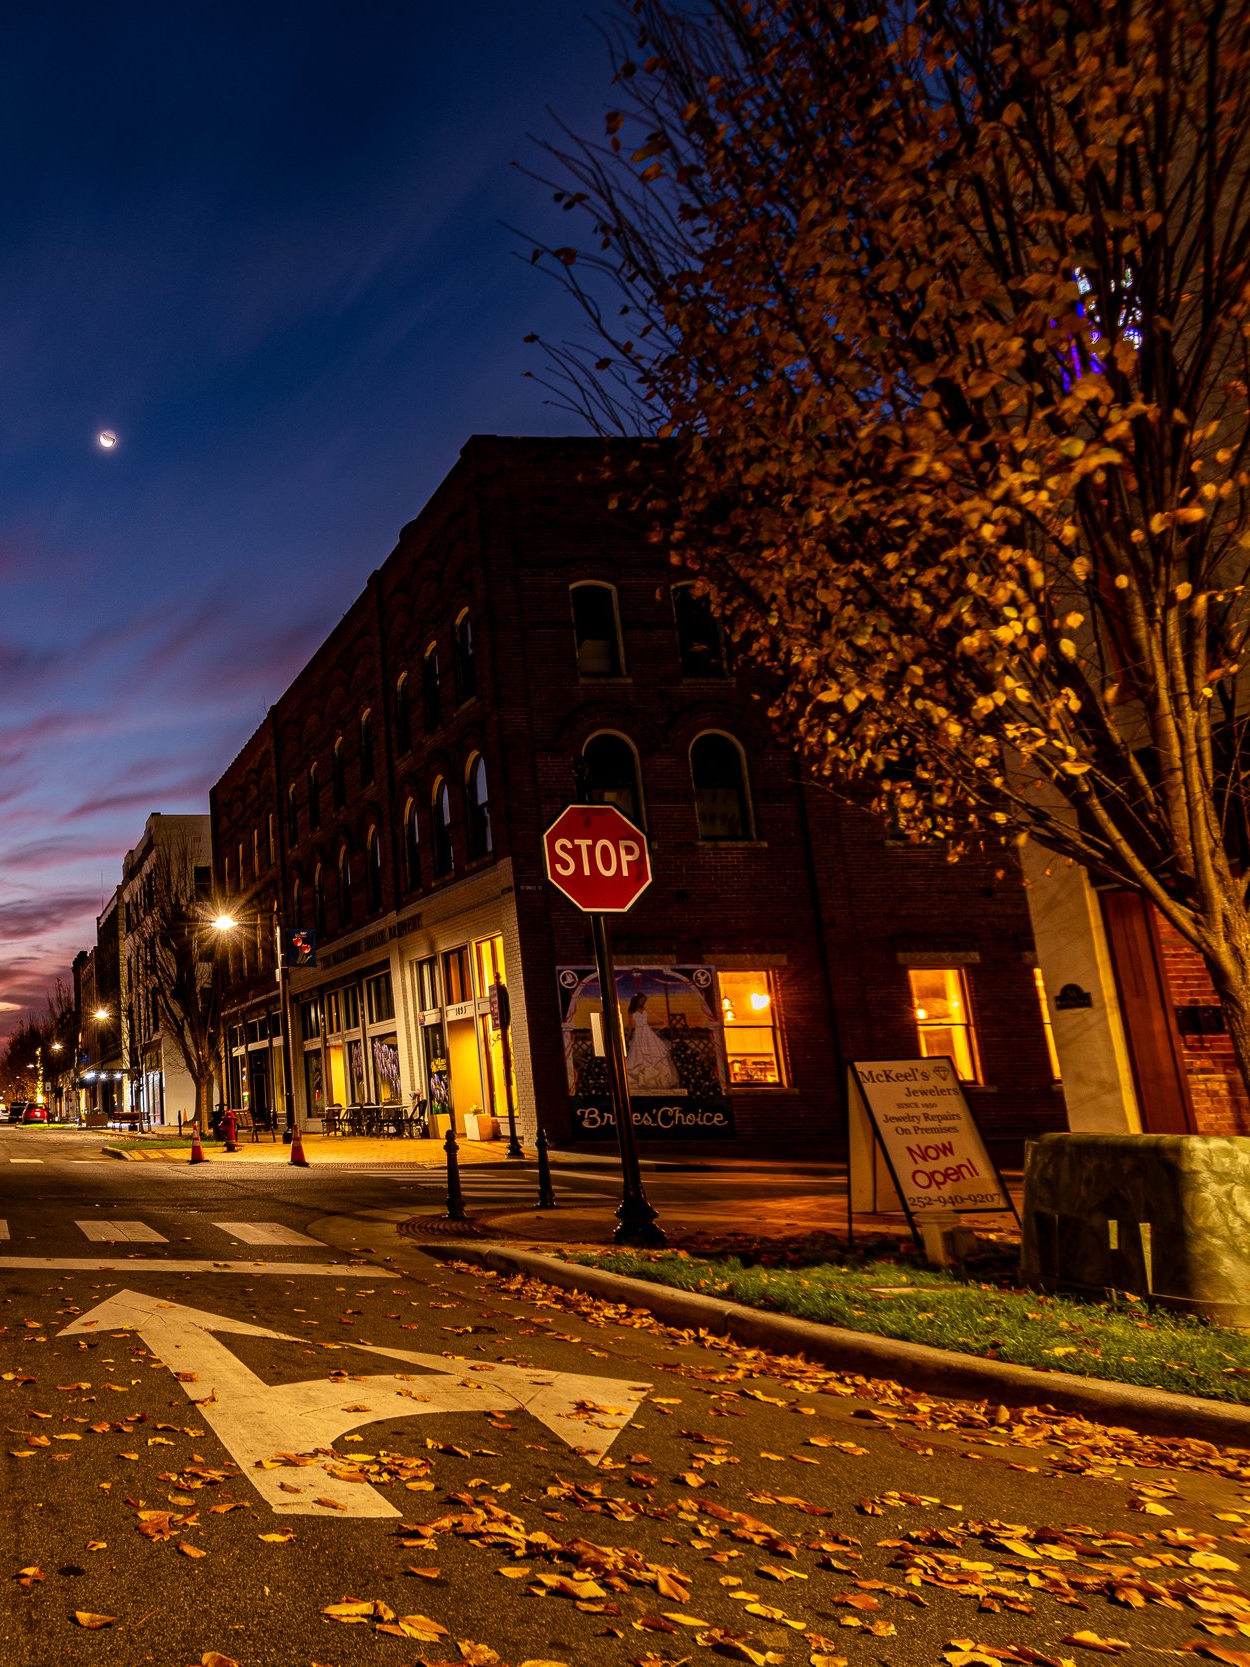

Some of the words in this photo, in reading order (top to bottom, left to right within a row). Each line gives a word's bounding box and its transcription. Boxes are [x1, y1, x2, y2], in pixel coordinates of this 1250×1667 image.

[554, 838, 640, 877] STOP
[858, 1067, 931, 1084] McKeel's
[905, 1086, 959, 1097] Jewelers
[576, 1107, 658, 1129] Bres'
[657, 1106, 729, 1129] Choice
[883, 1113, 921, 1125] Jewelry
[923, 1112, 962, 1123] Repairs
[895, 1126, 912, 1136] On
[913, 1124, 959, 1136] Premises
[906, 1140, 956, 1165] Now
[911, 1158, 980, 1190] Open!
[908, 1192, 1001, 1209] 252-940-9207
